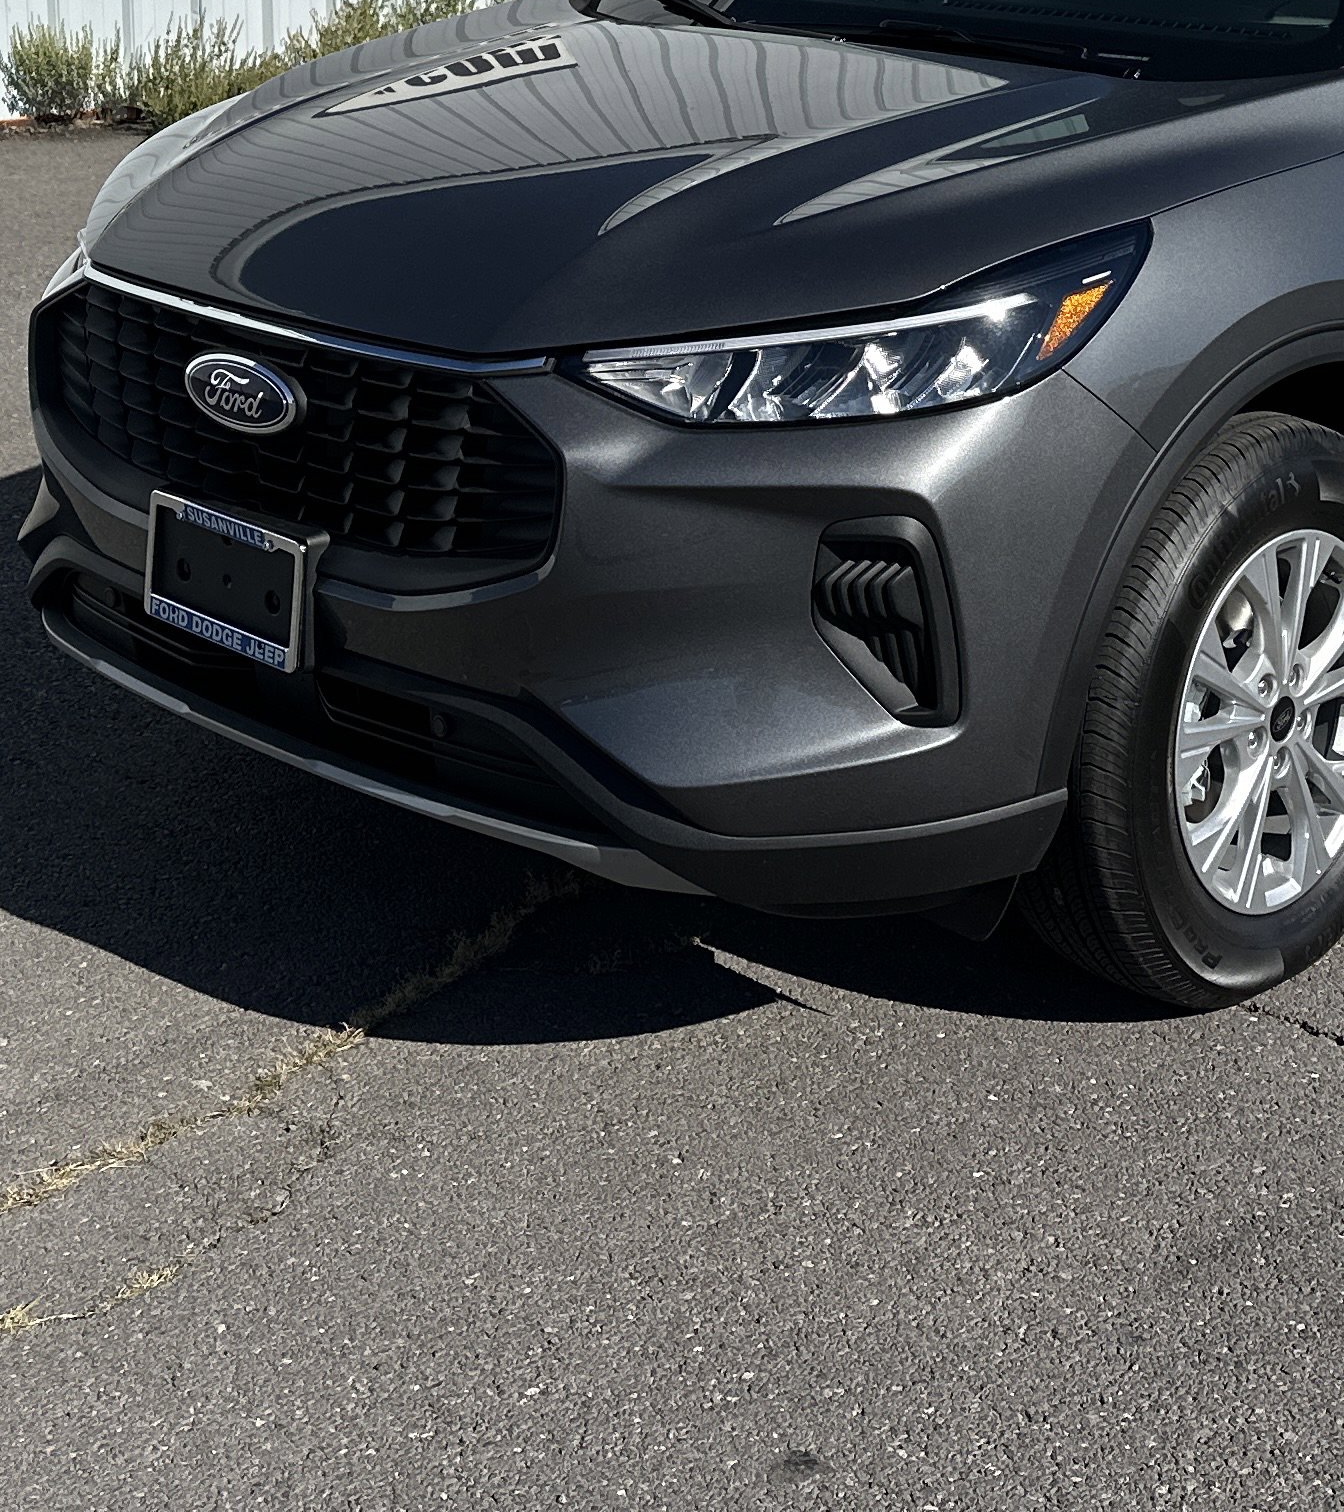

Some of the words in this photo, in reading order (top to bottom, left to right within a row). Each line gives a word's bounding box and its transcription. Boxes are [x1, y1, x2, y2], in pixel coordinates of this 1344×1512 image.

[204, 368, 264, 419] Ford
[187, 506, 263, 546] SUSANVILLE
[152, 598, 189, 628] FORD
[191, 616, 243, 651] DODGE
[245, 638, 285, 665] JEEP
